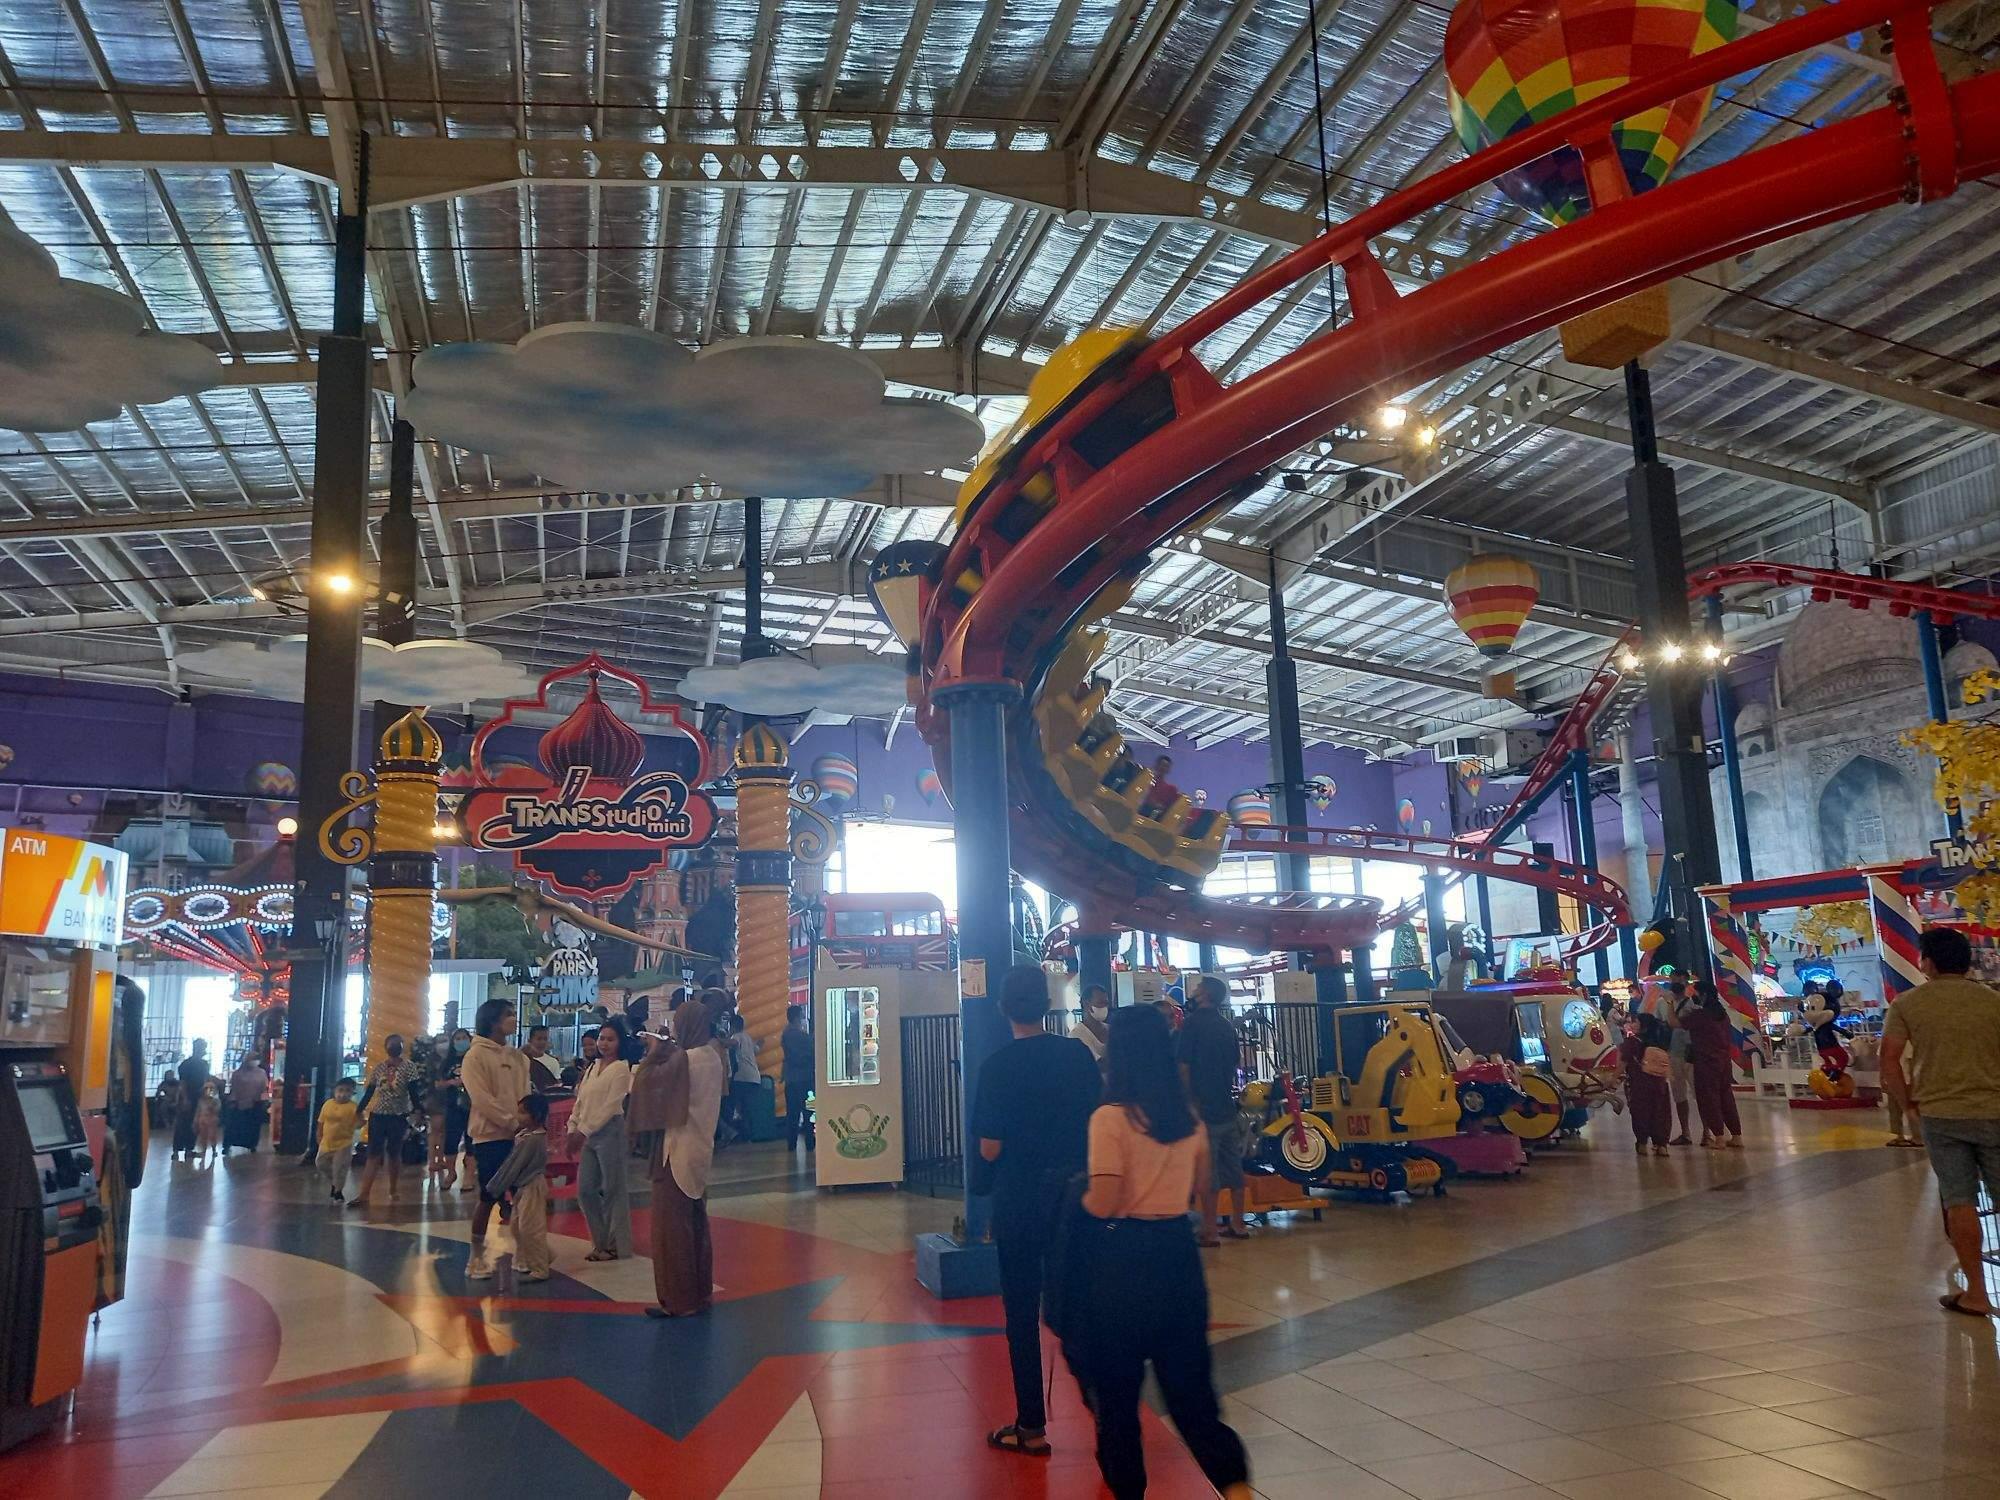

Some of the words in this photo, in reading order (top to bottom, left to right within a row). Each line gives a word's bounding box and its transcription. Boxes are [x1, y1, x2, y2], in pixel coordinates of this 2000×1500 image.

[647, 819, 685, 833] mini
[10, 837, 47, 857] ATM
[553, 960, 586, 976] PARIS
[539, 976, 599, 1006] SWING
[1347, 1115, 1371, 1136] CAT
